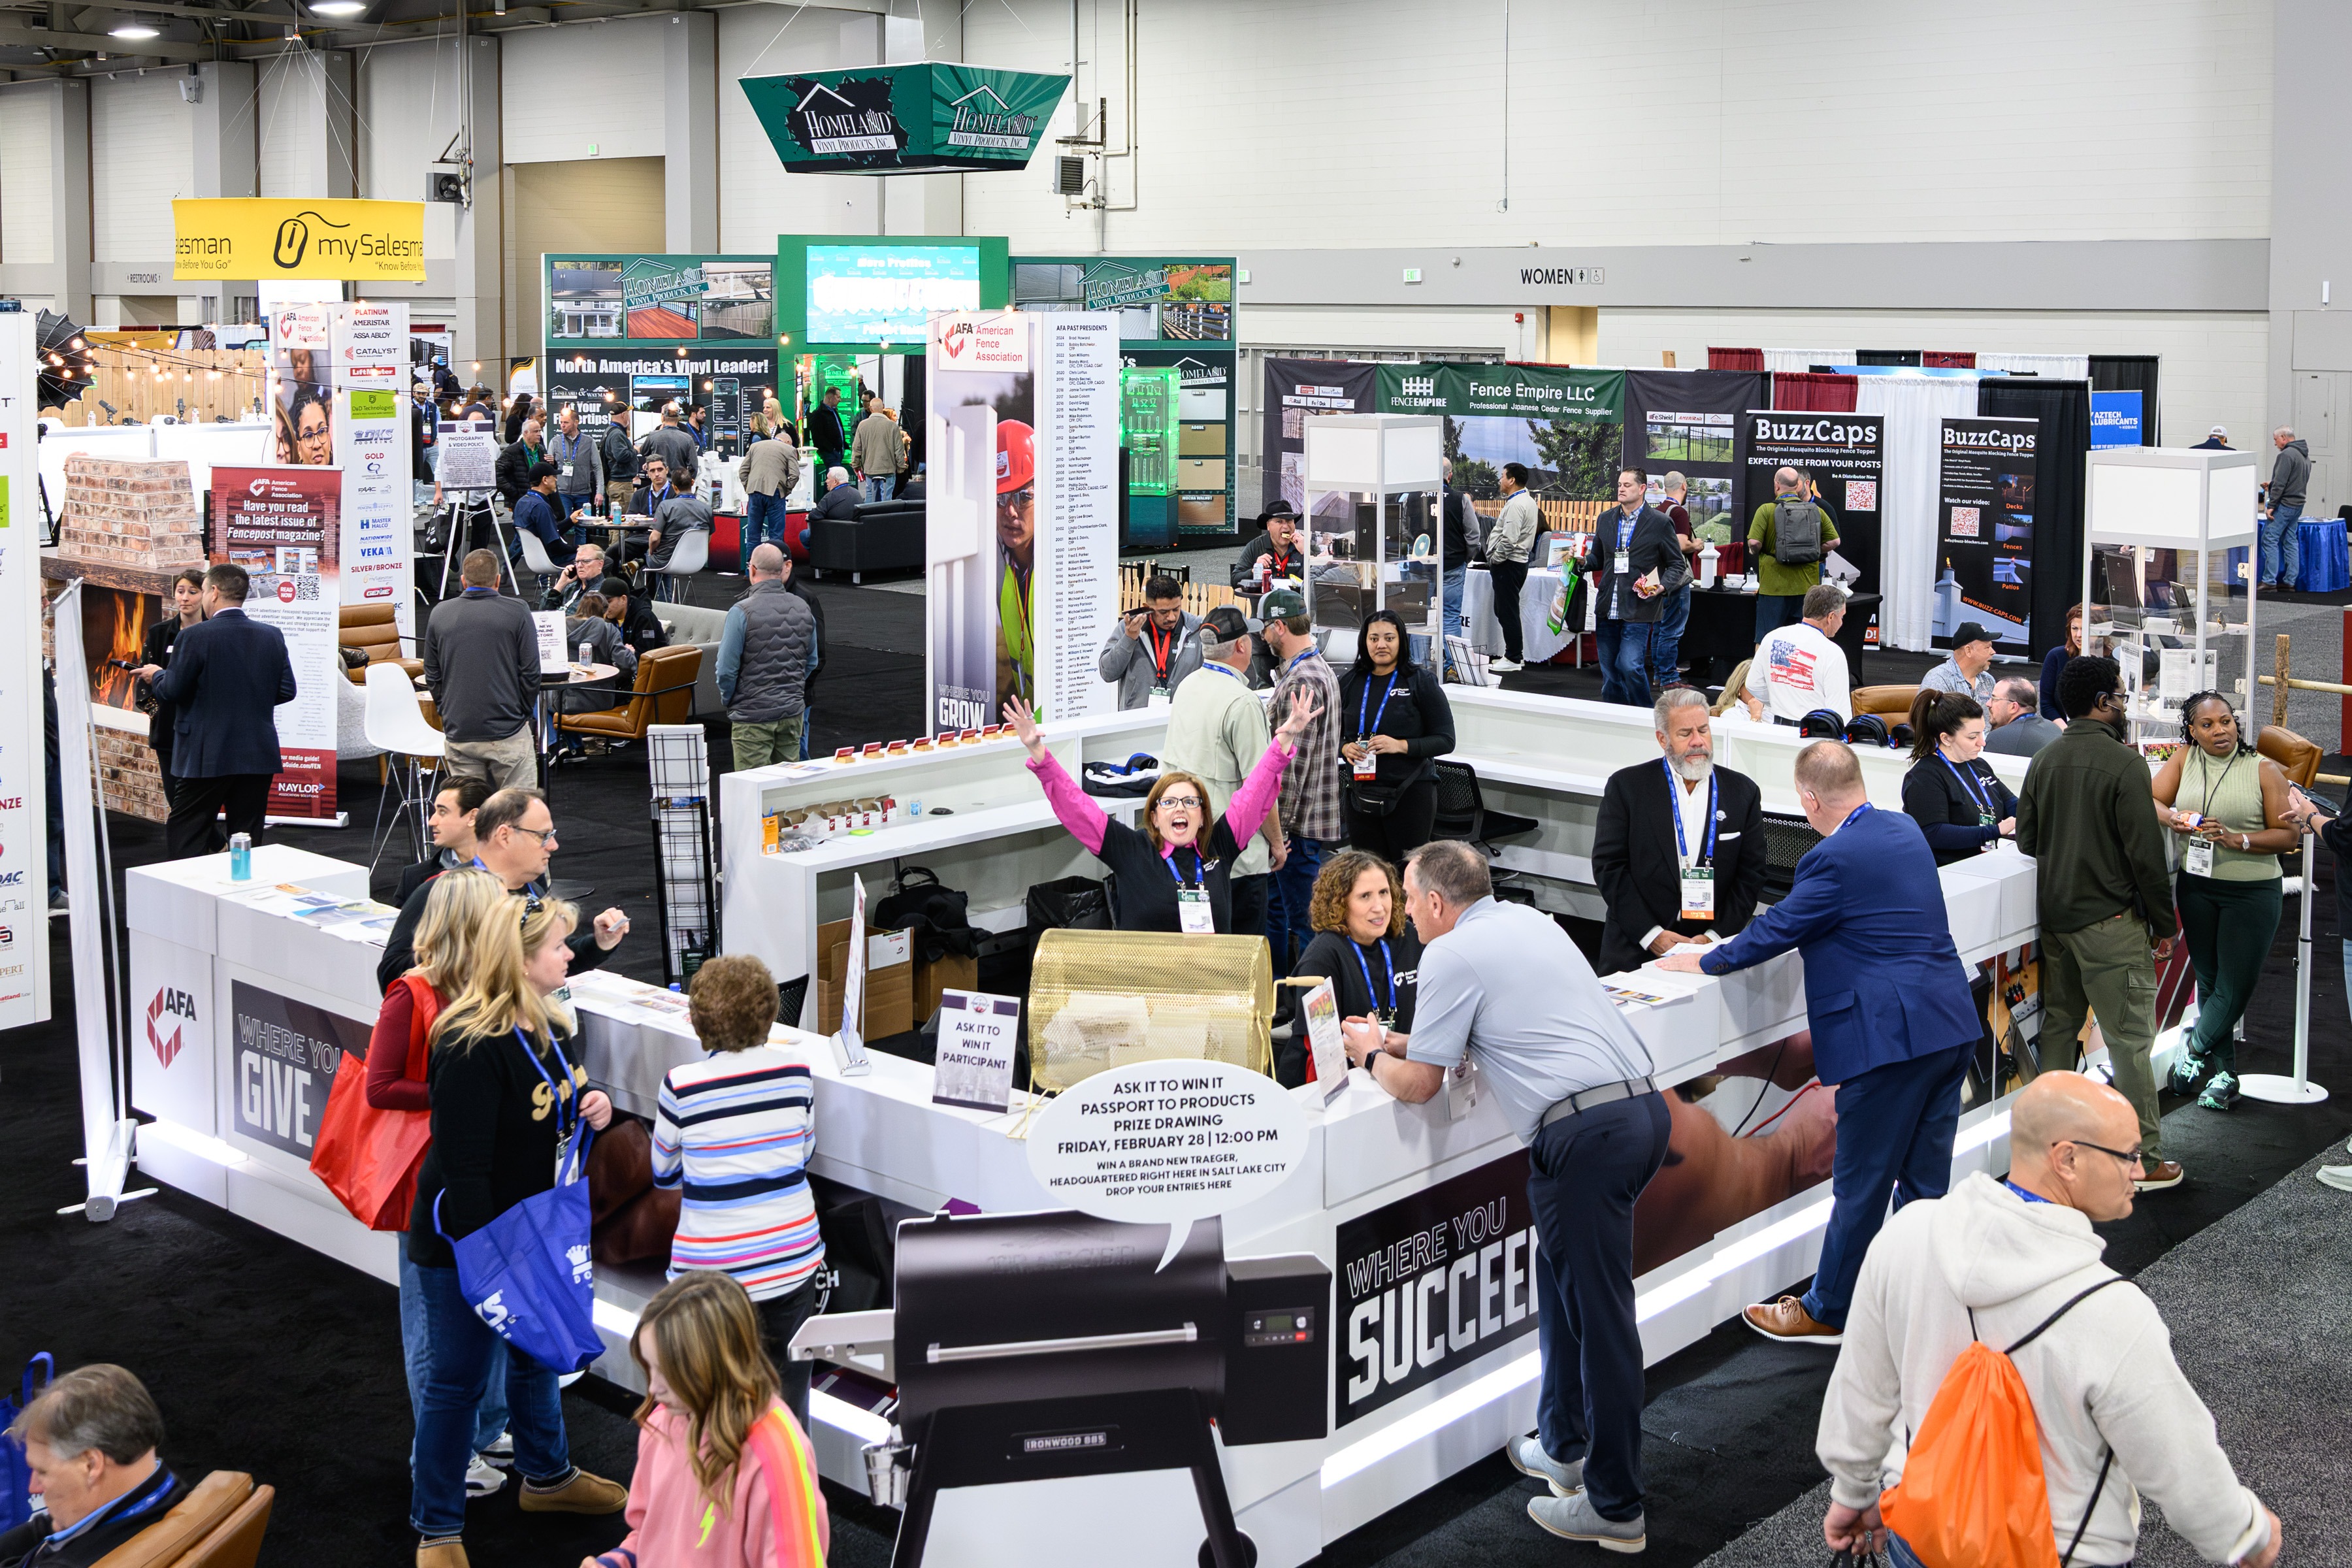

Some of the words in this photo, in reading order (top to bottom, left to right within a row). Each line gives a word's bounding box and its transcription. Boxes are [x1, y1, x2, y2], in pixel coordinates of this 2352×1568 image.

[804, 108, 892, 138] HOMELAND
[953, 106, 1034, 136] HOMELAND
[815, 139, 835, 153] VINYL
[838, 138, 874, 152] PRODUCTS,
[875, 137, 890, 149] INC.
[954, 133, 973, 146] VINYL
[975, 134, 1007, 146] PRODUCTS,
[1009, 137, 1022, 148] INC.
[130, 273, 157, 283] RESTROOMS
[622, 267, 707, 297] HOMELAND
[1086, 269, 1168, 299] HOMELAND
[1521, 269, 1573, 284] WOMEN
[955, 323, 973, 334] AFA
[976, 325, 1013, 335] American
[976, 339, 1000, 348] Fence
[976, 352, 1022, 362] Association
[675, 359, 711, 374] Vinyl
[713, 359, 768, 374] Leader!
[1470, 382, 1511, 397] Fence
[1516, 383, 1562, 401] Empire
[1567, 386, 1595, 401] LLC
[1511, 403, 1539, 412] Japanese
[1585, 408, 1612, 416] Supplier
[1756, 419, 1876, 448] BuzzCaps
[1944, 428, 2035, 452] BuzzCaps
[244, 500, 266, 511] Have
[269, 502, 285, 514] you
[287, 502, 308, 512] read
[235, 514, 251, 525] the
[253, 514, 279, 526] latest
[281, 515, 304, 527] issue
[307, 516, 317, 527] of
[227, 527, 274, 540] Fencepost
[277, 530, 325, 542] magazine?
[361, 547, 384, 557] VEKA
[351, 563, 402, 573] SILVER/BRONZE
[1963, 596, 2022, 623] WWW.BUZZ-CAPS.COM
[938, 684, 970, 700] WHERE
[971, 689, 990, 702] YOU
[939, 697, 985, 730] GROW
[278, 783, 319, 793] NAYLOR
[165, 987, 197, 1021] AFA
[956, 1022, 974, 1032] ASK
[977, 1024, 985, 1034] IT
[988, 1026, 1000, 1036] TO
[238, 1013, 306, 1064] WHERE
[962, 1039, 980, 1049] WIN
[983, 1042, 990, 1051] IT
[943, 1053, 1006, 1070] PARTICIPANT
[1114, 1083, 1141, 1094] ASK
[1145, 1081, 1156, 1092] IT
[1160, 1079, 1178, 1092] TO
[1182, 1078, 1209, 1090] WIN
[1213, 1077, 1223, 1088] IT
[241, 1050, 312, 1148] GIVE
[1081, 1100, 1154, 1115] PASSPORT
[1158, 1099, 1176, 1110] TO
[1180, 1094, 1254, 1109] PRODUCTS
[1114, 1119, 1151, 1132] PRIZE
[1155, 1115, 1223, 1129] DRAWING
[1058, 1140, 1110, 1154] FRIDAY,
[1114, 1136, 1184, 1151] FEBRUARY
[1188, 1134, 1205, 1145] 28
[1215, 1131, 1254, 1144] 12:00
[1257, 1129, 1278, 1141] PM
[1097, 1160, 1116, 1170] WIN
[1119, 1160, 1126, 1168] A
[1129, 1158, 1164, 1168] BRAND
[1166, 1156, 1188, 1166] NEW
[1191, 1154, 1238, 1165] TRAEGER,
[1050, 1172, 1137, 1186] HEADQUARTERED
[1140, 1170, 1171, 1181] RIGHT
[1173, 1168, 1197, 1179] HERE
[1200, 1168, 1209, 1177] IN
[1212, 1166, 1235, 1177] SALT
[1237, 1164, 1262, 1175] LAKE
[1264, 1163, 1286, 1173] CITY
[1106, 1186, 1134, 1196] DROP
[1137, 1184, 1164, 1194] YOUR
[1166, 1182, 1205, 1193] ENTRIES
[1208, 1180, 1232, 1190] HERE
[1347, 1222, 1447, 1299] WHERE
[1453, 1196, 1506, 1250] YOU
[1026, 1436, 1082, 1450] IRONWOOD
